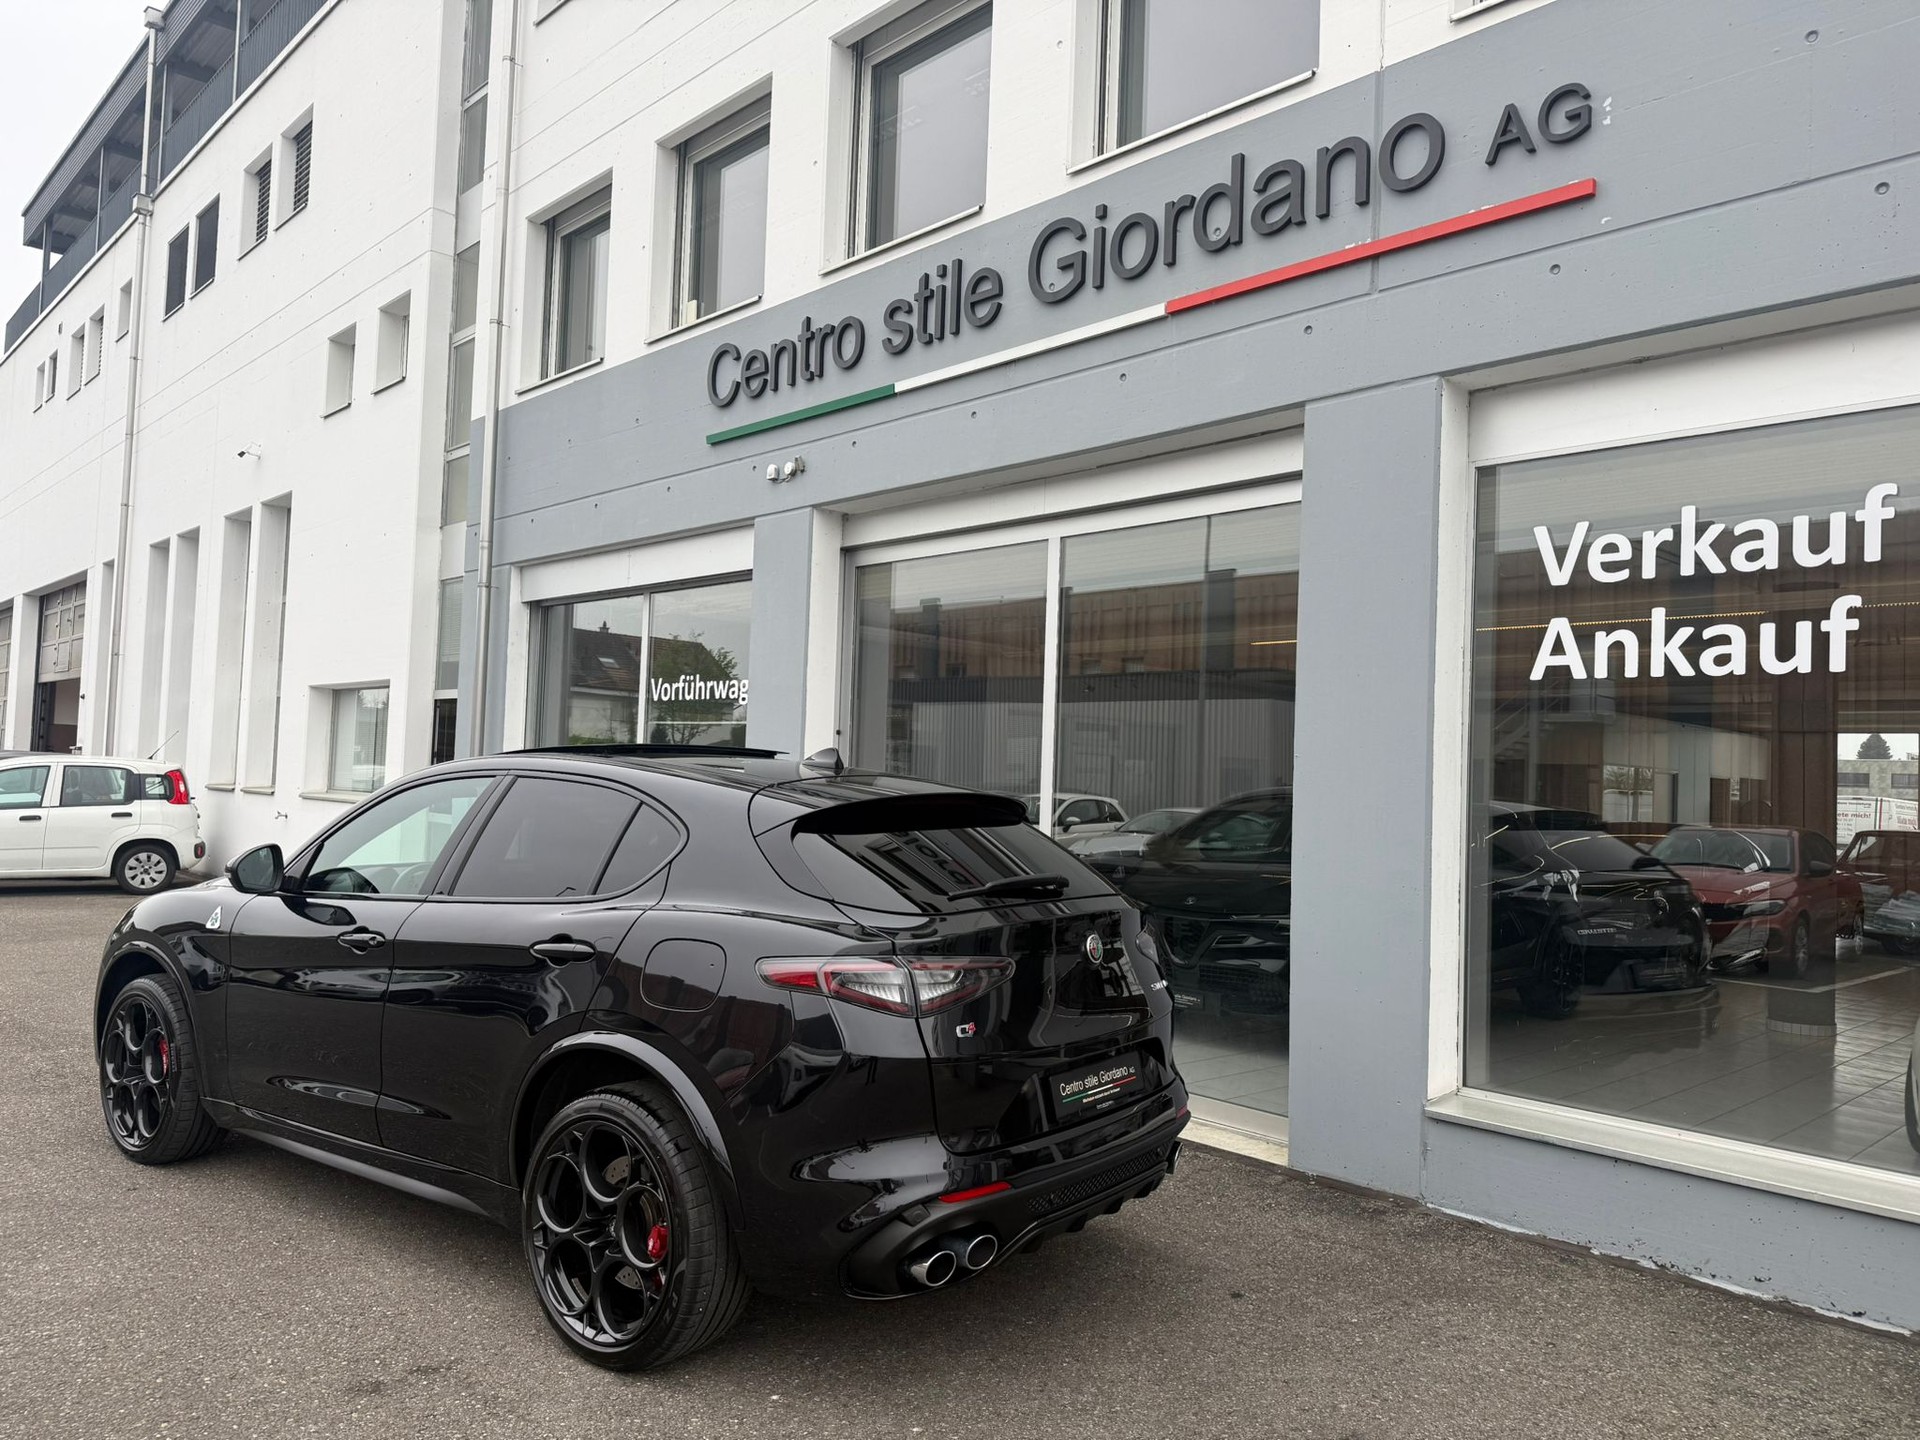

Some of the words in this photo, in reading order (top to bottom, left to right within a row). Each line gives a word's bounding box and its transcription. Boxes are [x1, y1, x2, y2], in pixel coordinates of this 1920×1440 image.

[707, 315, 865, 407] Centro
[882, 258, 1004, 354] stile
[1028, 112, 1446, 302] Giordano
[1485, 82, 1593, 166] AG
[1532, 482, 1899, 587] Verkauf
[1529, 594, 1863, 681] Ankauf
[651, 674, 749, 705] Vorführwag
[1060, 1080, 1084, 1096] Centro
[1084, 1074, 1099, 1088] stile
[1099, 1066, 1129, 1083] Giordano
